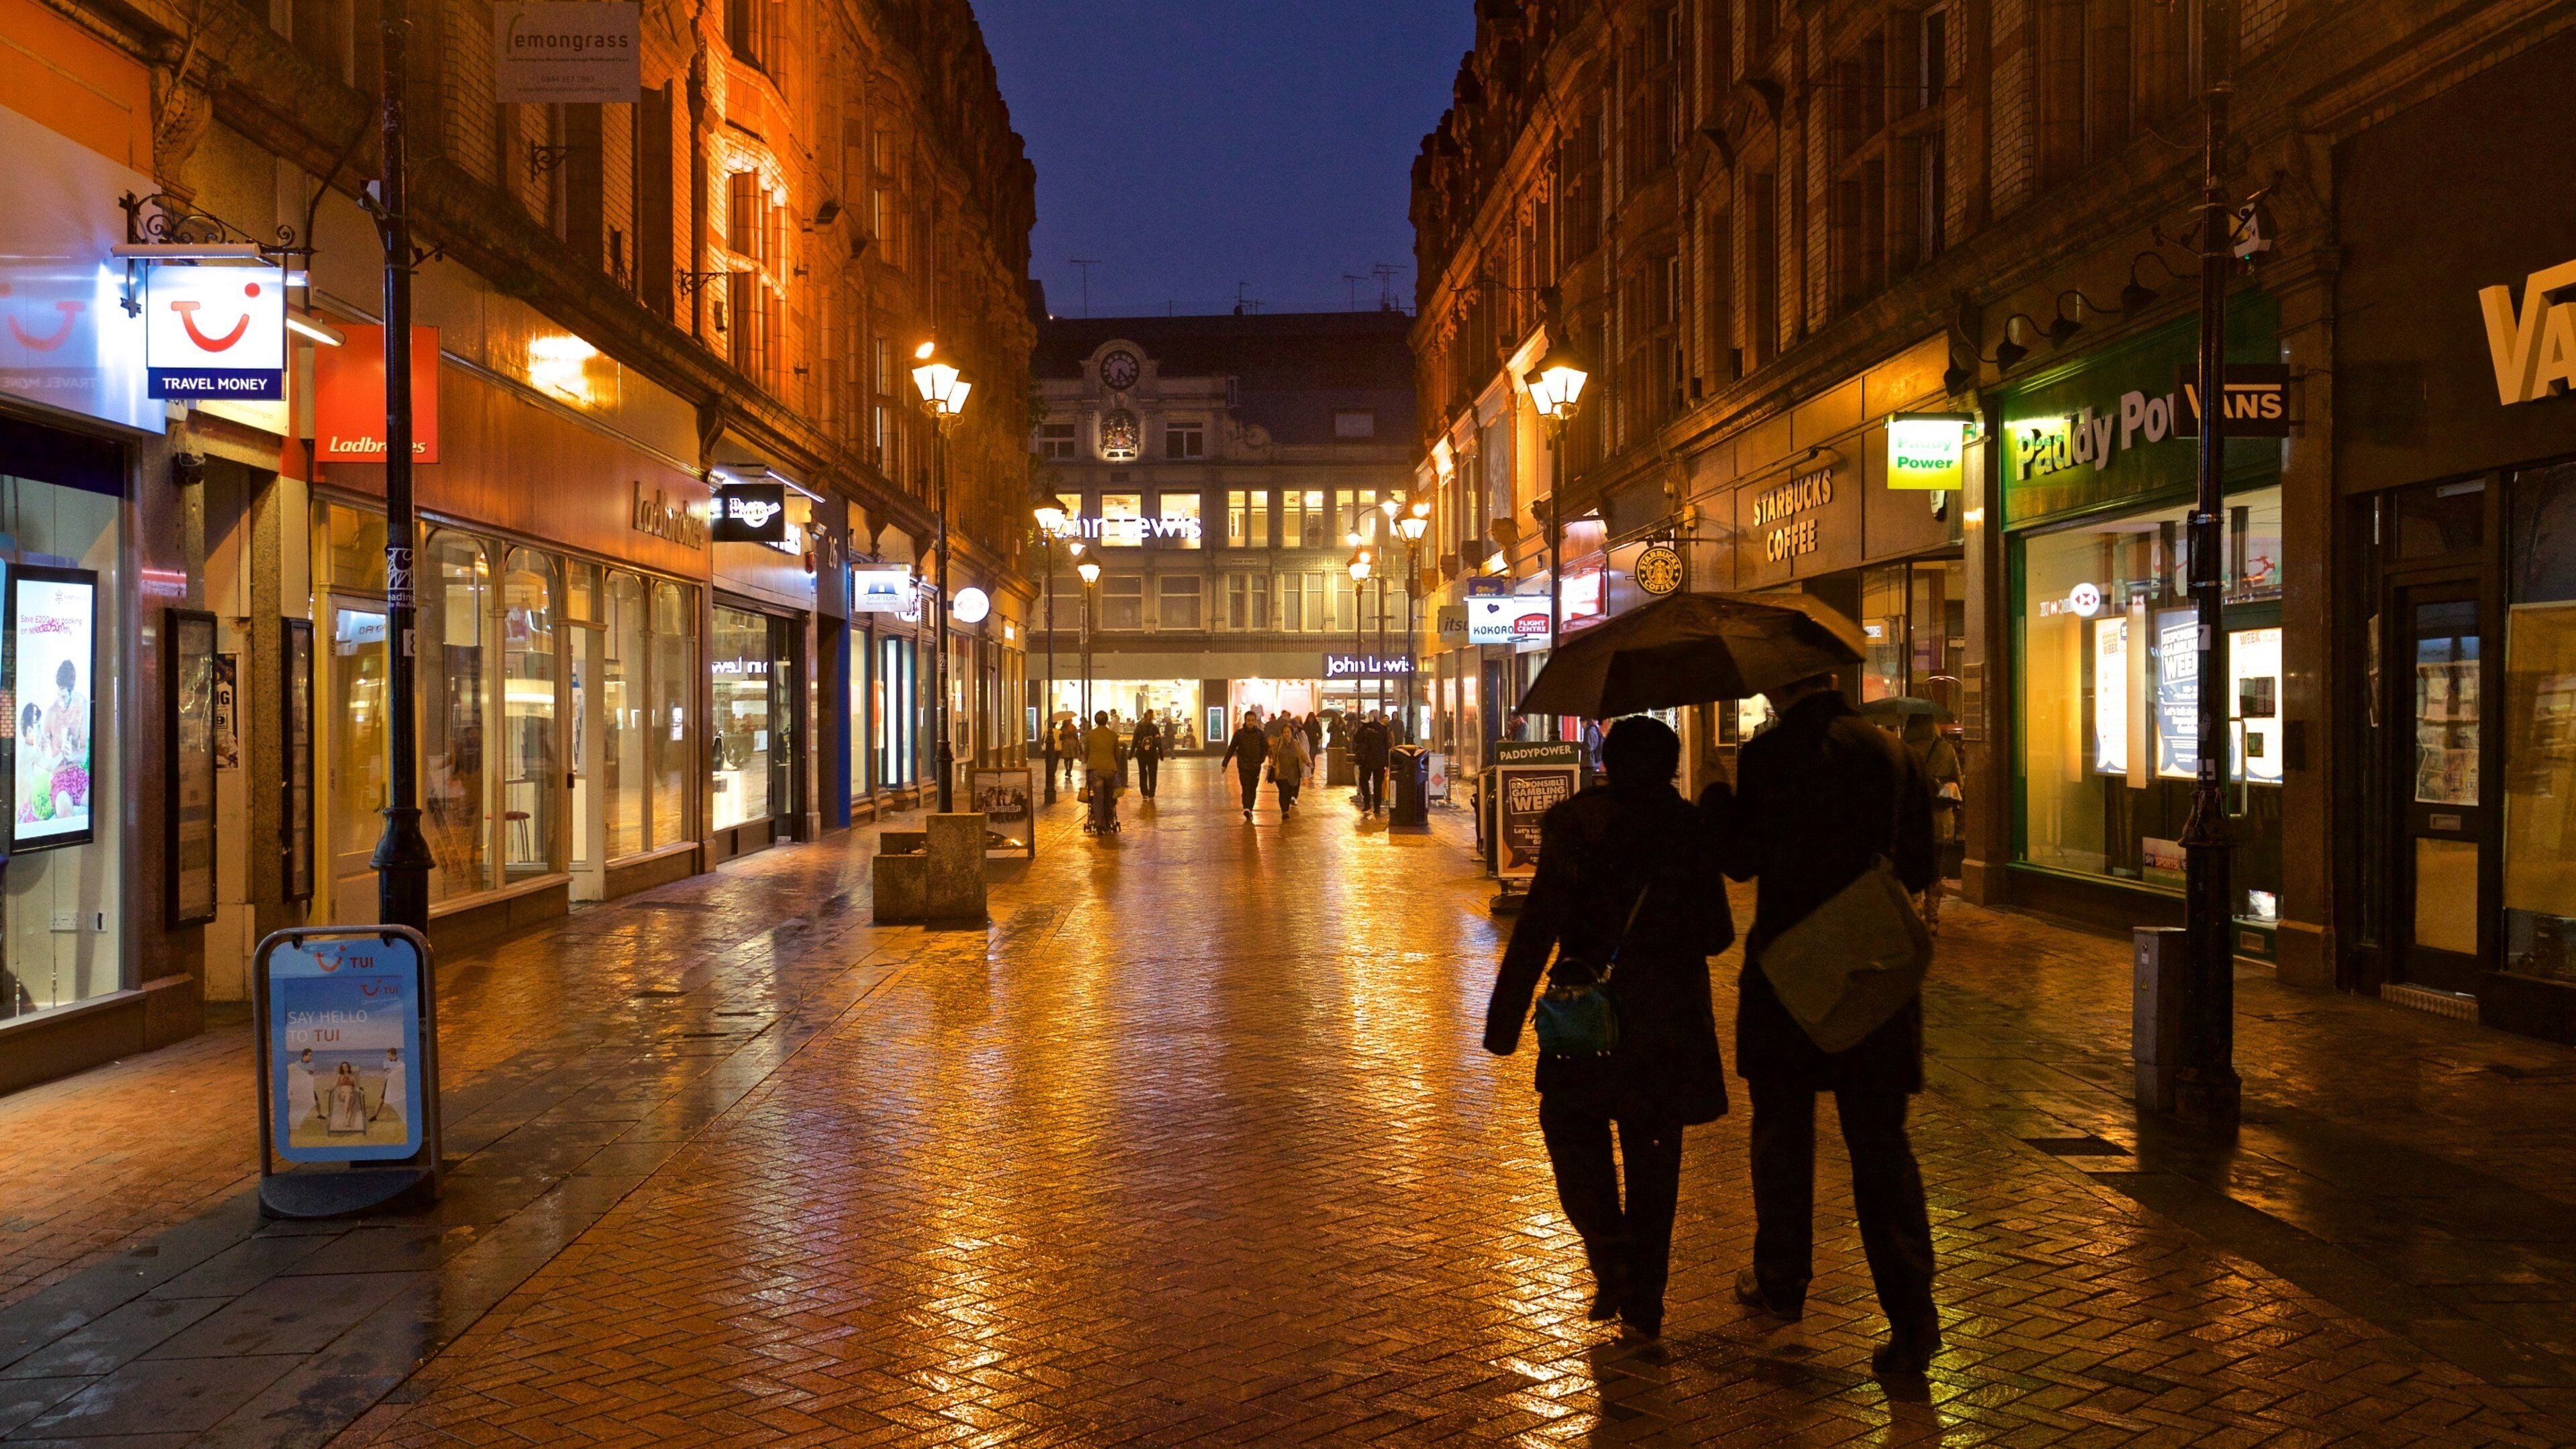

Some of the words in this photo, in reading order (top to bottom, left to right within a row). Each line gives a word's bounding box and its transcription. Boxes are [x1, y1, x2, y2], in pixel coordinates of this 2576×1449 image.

[162, 378, 214, 390] TRAVEL
[218, 378, 268, 390] MONEY
[329, 436, 426, 454] Ladbres
[1897, 456, 1953, 468] Power
[1754, 469, 1831, 527] STARBUCKS
[1767, 519, 1815, 562] COFFEE
[828, 535, 838, 570] 26
[1640, 551, 1680, 571] STARBUCKS
[1644, 580, 1676, 591] COFFEE
[21, 615, 34, 623] Save
[1474, 625, 1513, 635] KOKORO
[2240, 631, 2260, 645] WEEK
[1326, 655, 1366, 677] John
[1511, 778, 1564, 789] RESPONSIBLE
[1512, 786, 1565, 797] GAMBLING
[2155, 857, 2179, 869] SPORTS
[350, 957, 373, 969] TUI
[384, 985, 398, 995] TUI
[288, 1011, 315, 1024] SAY
[320, 1010, 368, 1024] HELLO
[288, 1030, 309, 1042] TO
[314, 1029, 339, 1042] TUI
